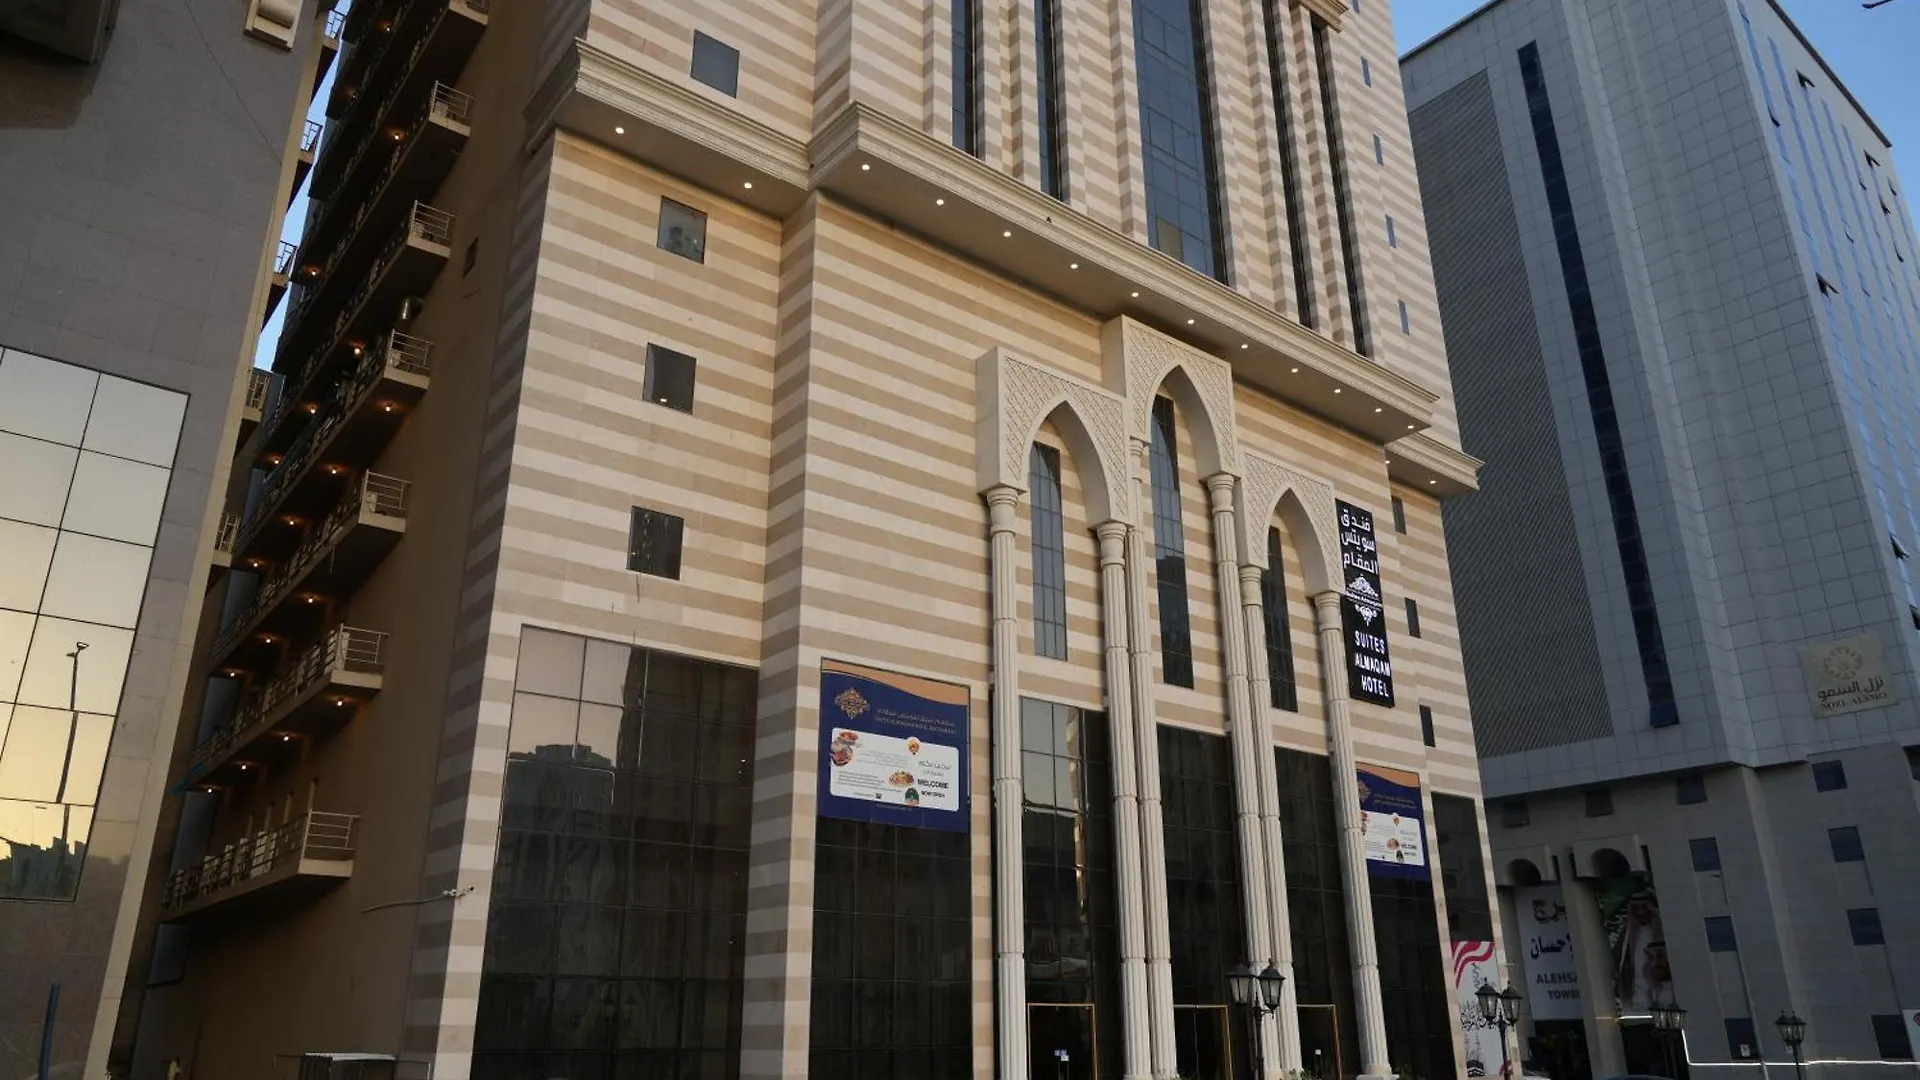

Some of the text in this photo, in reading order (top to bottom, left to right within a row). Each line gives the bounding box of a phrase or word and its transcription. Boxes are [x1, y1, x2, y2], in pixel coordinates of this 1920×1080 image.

[1341, 508, 1371, 532] فندق
[1341, 529, 1375, 552] سويتس
[1343, 551, 1379, 575] المقام
[1354, 630, 1385, 654] SUITES
[1354, 652, 1391, 676] ALMAQAM
[1361, 674, 1389, 697] HOTEL
[1817, 676, 1884, 702] نزل السمو
